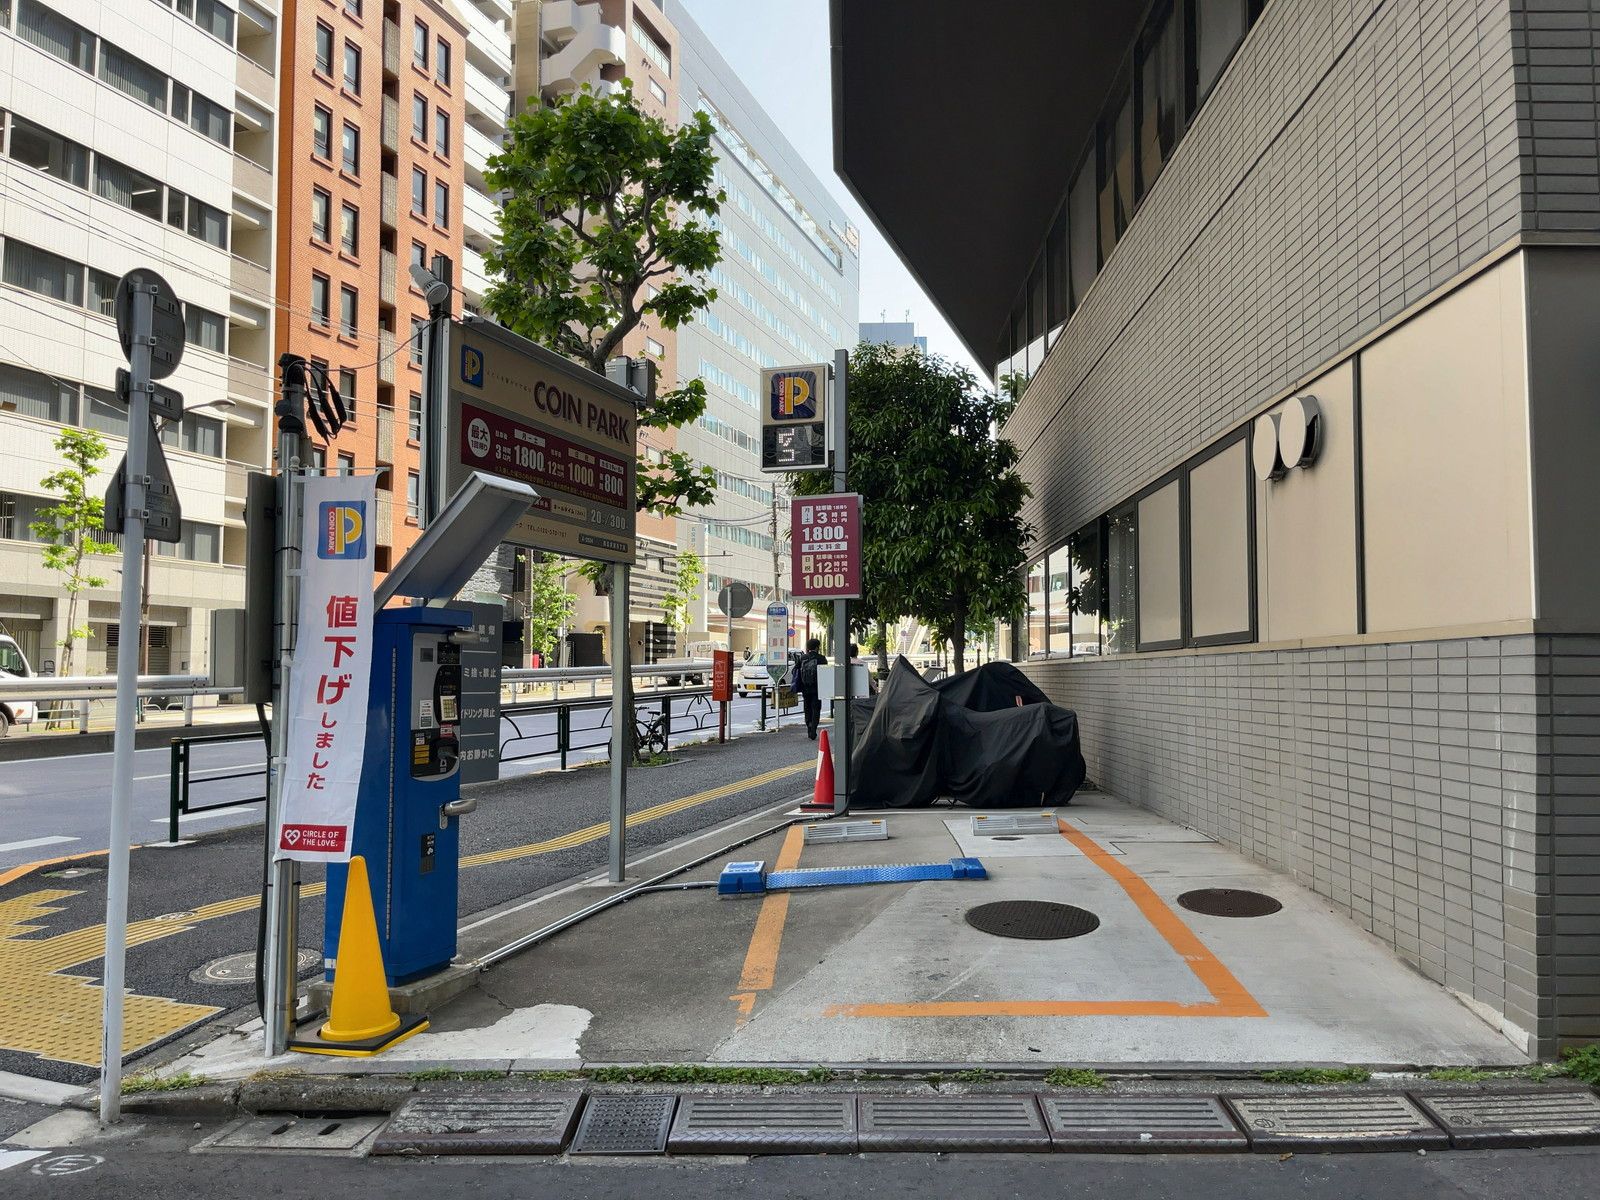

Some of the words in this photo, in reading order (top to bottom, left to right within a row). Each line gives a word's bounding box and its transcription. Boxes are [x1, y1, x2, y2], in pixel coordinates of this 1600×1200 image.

[784, 376, 810, 415] P
[533, 380, 582, 426] COIN
[587, 402, 630, 444] PARK
[471, 424, 488, 442] 最大
[495, 444, 502, 460] 3
[547, 460, 557, 476] 12
[604, 473, 623, 497] 800
[816, 511, 828, 524] 3
[335, 506, 363, 555] P
[807, 543, 842, 551] 最大料金
[816, 561, 833, 573] 12
[306, 595, 359, 790] 値下げしました
[302, 829, 326, 838] CIRCLE
[327, 830, 340, 839] OF
[302, 838, 316, 846] THE
[317, 839, 338, 847] LOVE.
